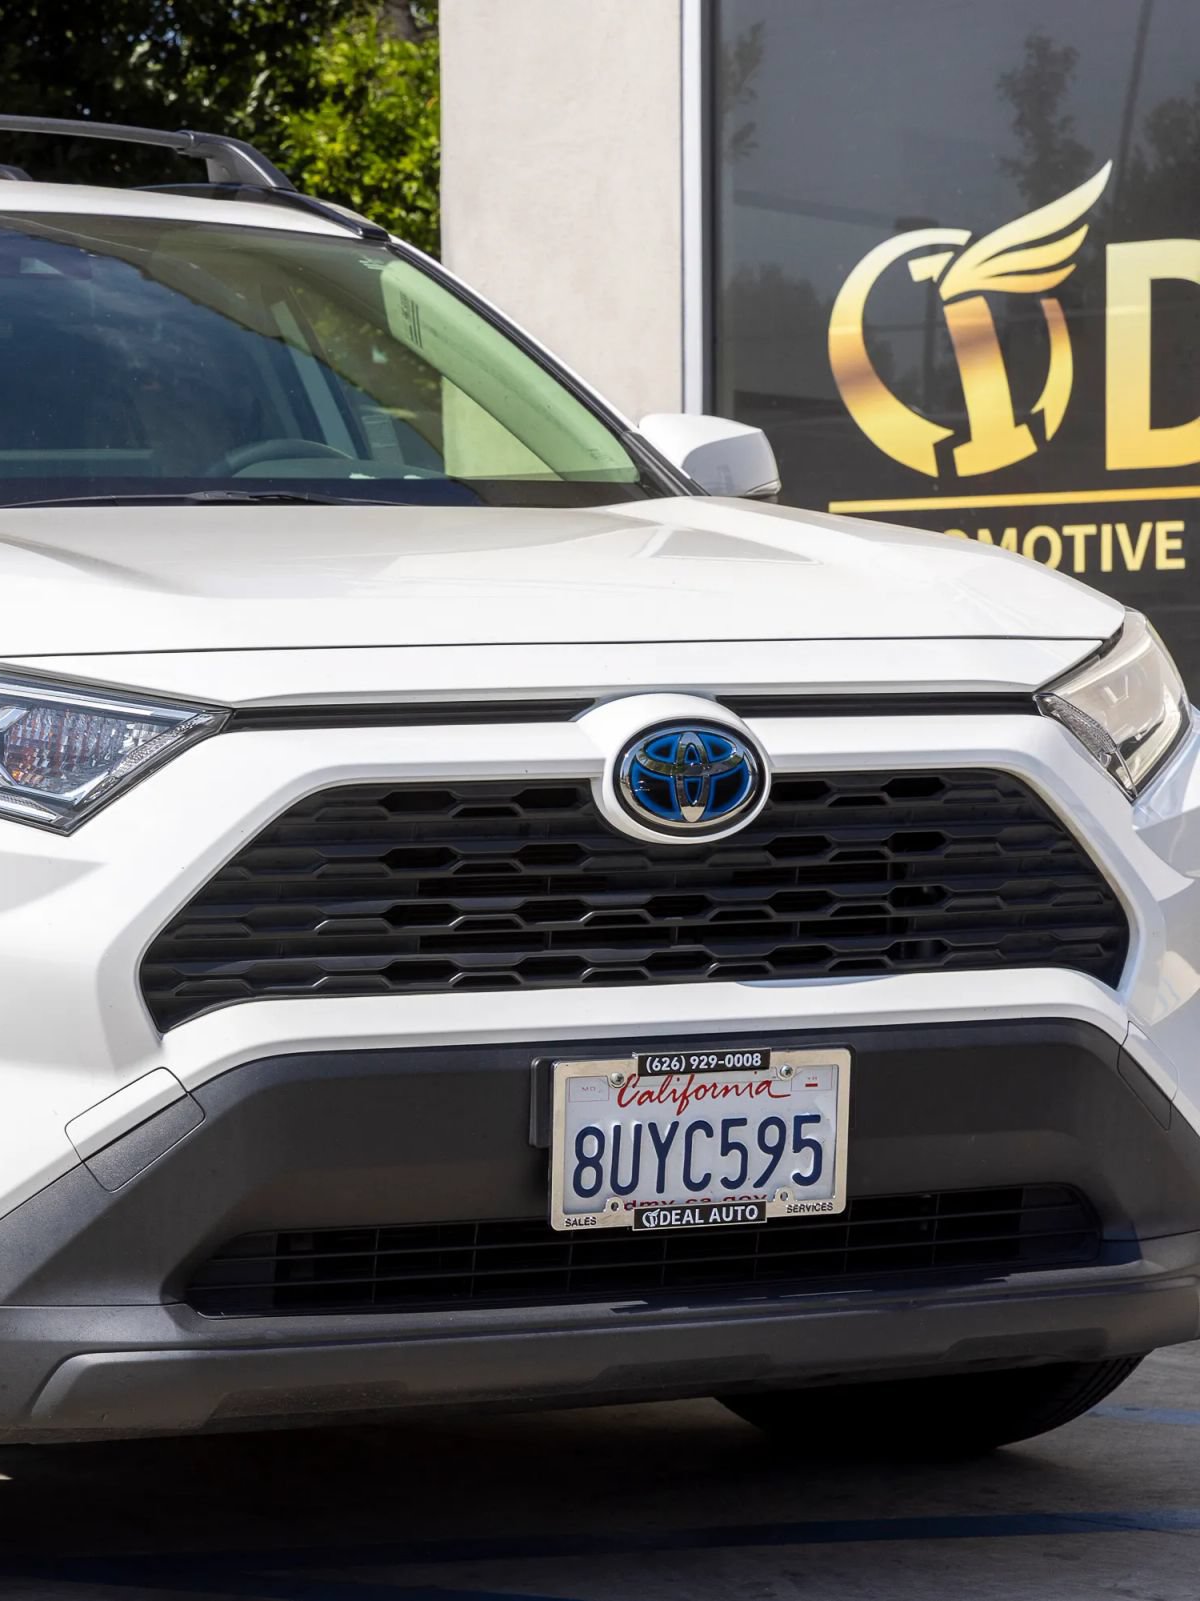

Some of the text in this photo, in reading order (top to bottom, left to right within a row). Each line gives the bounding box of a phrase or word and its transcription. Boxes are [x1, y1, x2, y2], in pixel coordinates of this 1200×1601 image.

[943, 520, 1186, 573] OTIVE
[646, 1053, 762, 1073] (626) 929-0008
[617, 1072, 791, 1116] California
[572, 1113, 823, 1198] 8UYC595
[709, 1205, 758, 1223] AUTO
[786, 1202, 833, 1213] SERVICES
[565, 1216, 597, 1227] SALES
